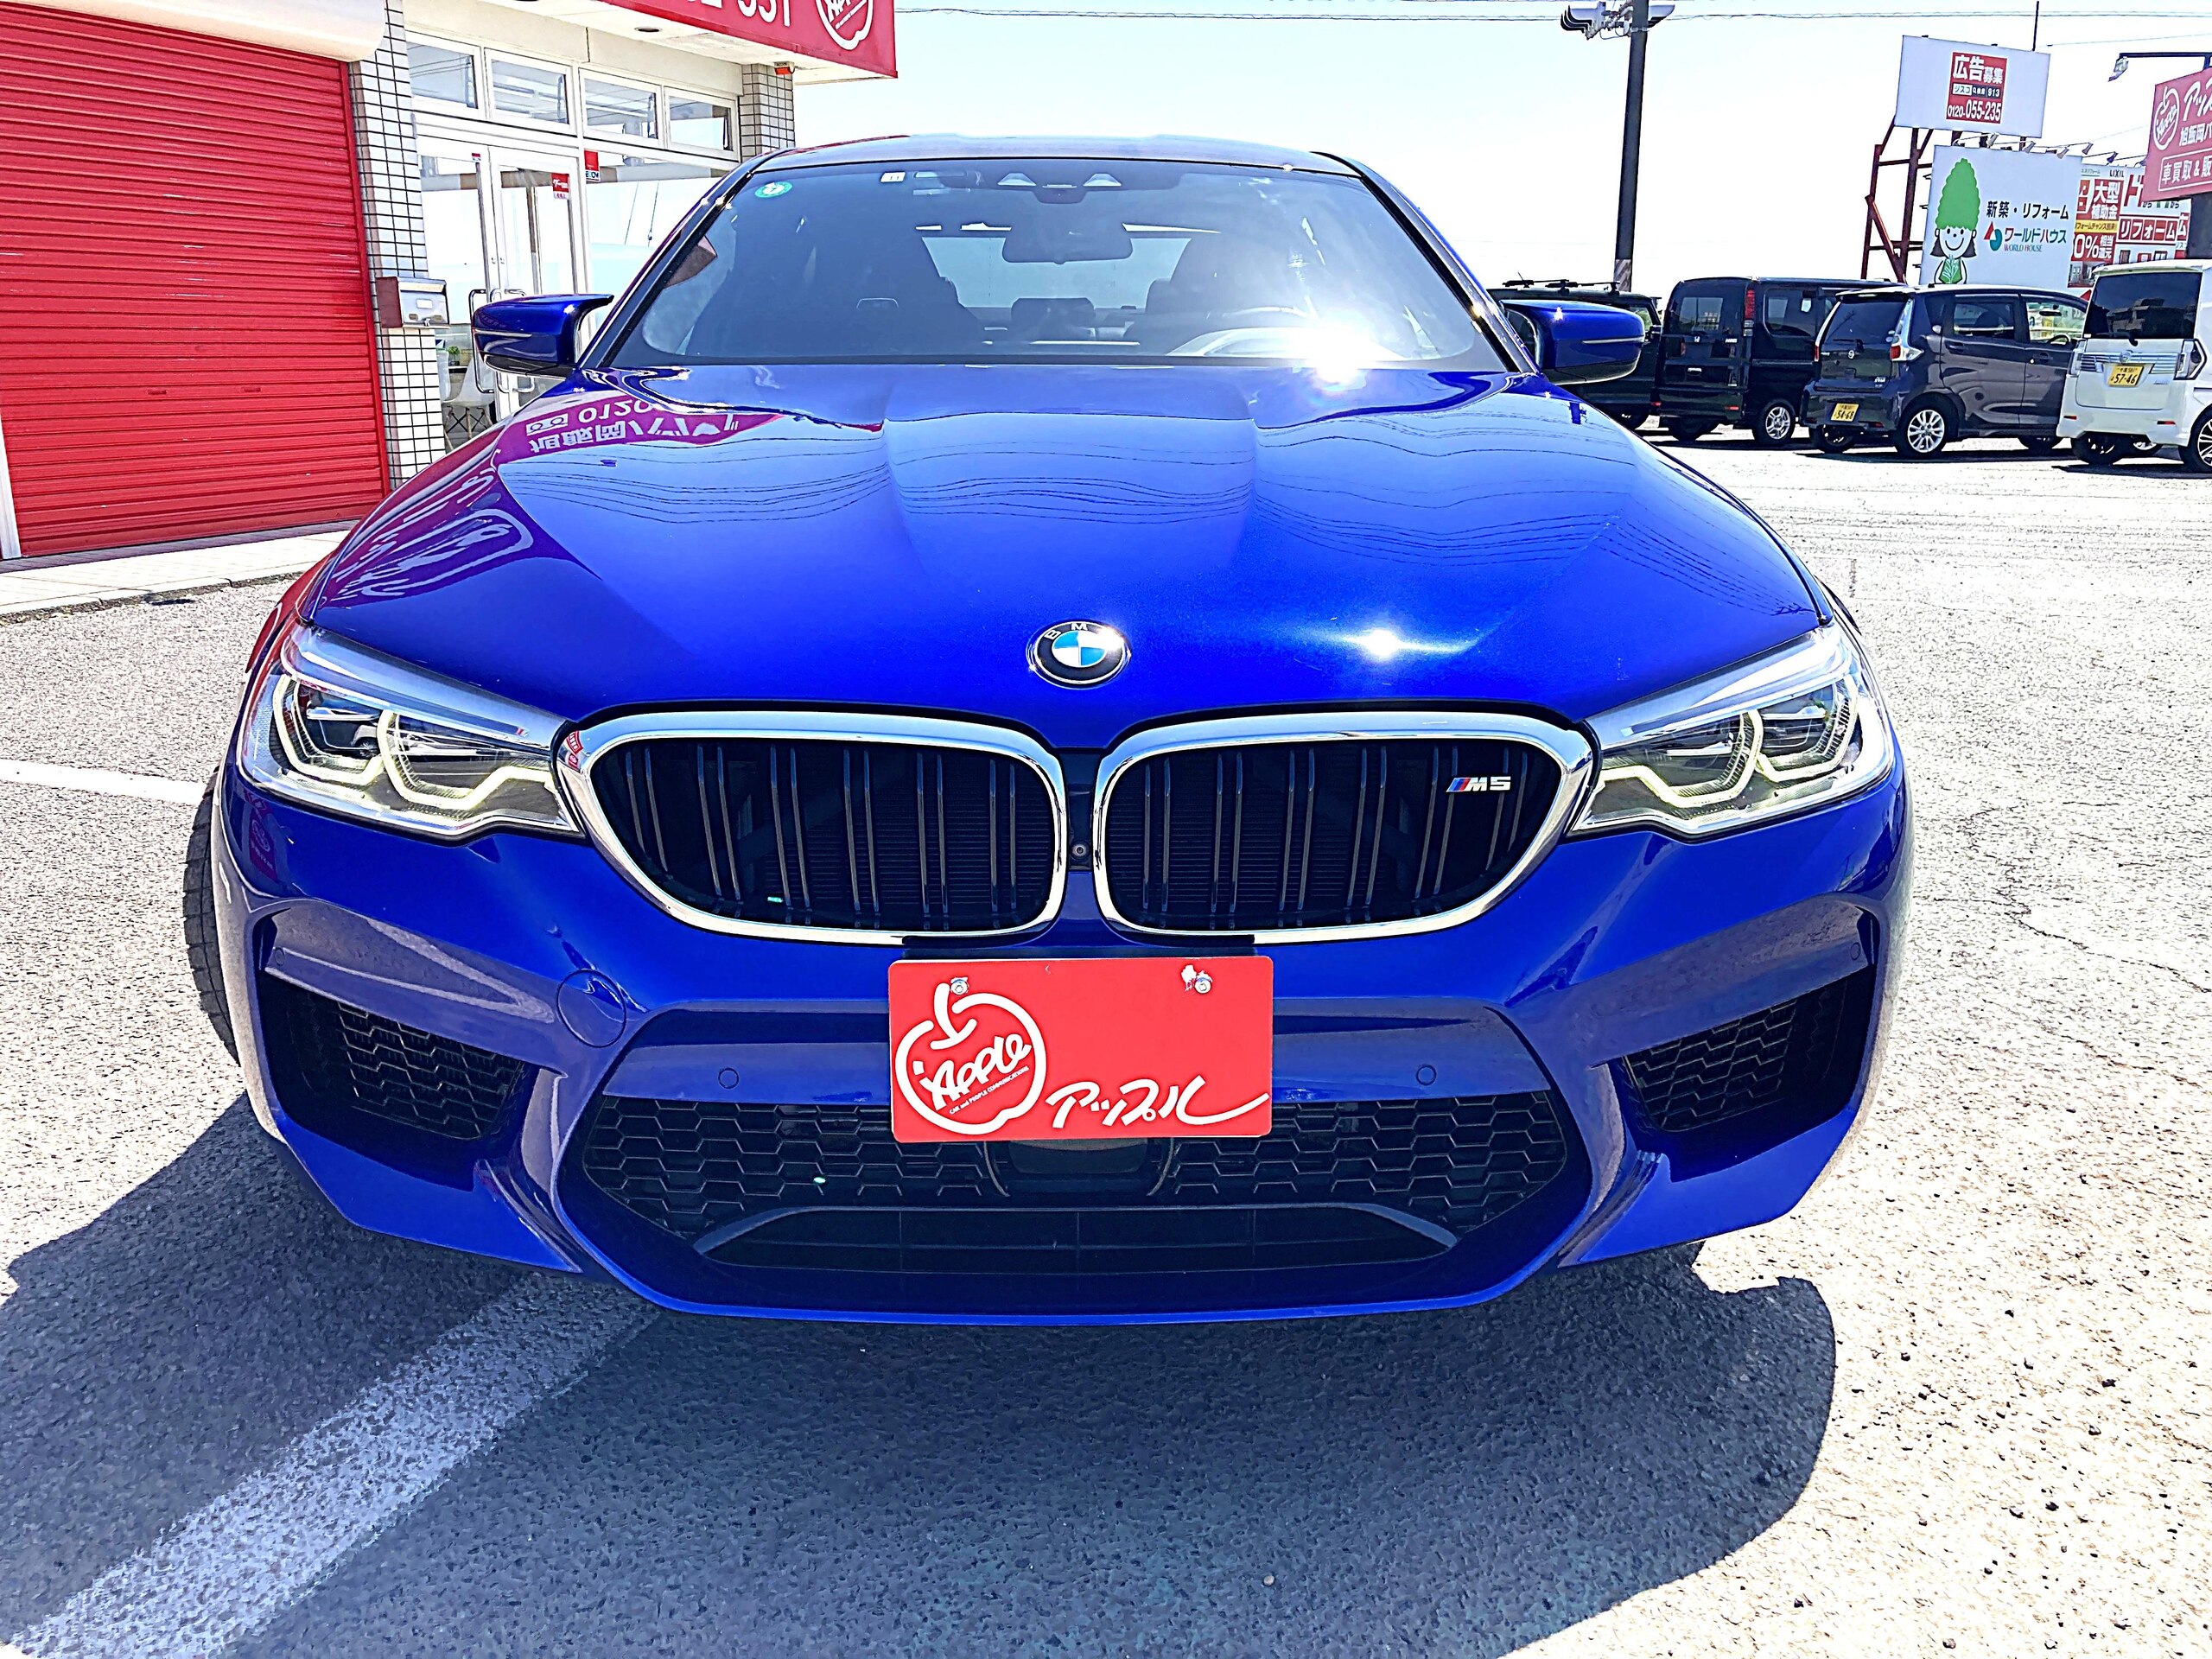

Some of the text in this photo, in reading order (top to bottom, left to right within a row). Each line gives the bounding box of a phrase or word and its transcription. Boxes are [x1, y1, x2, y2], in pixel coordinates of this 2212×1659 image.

[1953, 54, 2003, 84] 広告募集
[1987, 88, 2000, 97] 913
[1947, 99, 2002, 121] 0120-055-235
[2109, 169, 2125, 178] LIXIL
[2093, 180, 2121, 205] 大型
[1986, 200, 2069, 219] 新築・リフォーム
[2005, 227, 2066, 244] ワールドハウス
[2120, 220, 2176, 239] リフォーム
[2004, 244, 2024, 252] WORLD
[2113, 373, 2139, 385] 57-46
[1462, 776, 1511, 791] M5
[1045, 1074, 1270, 1129] アップル
